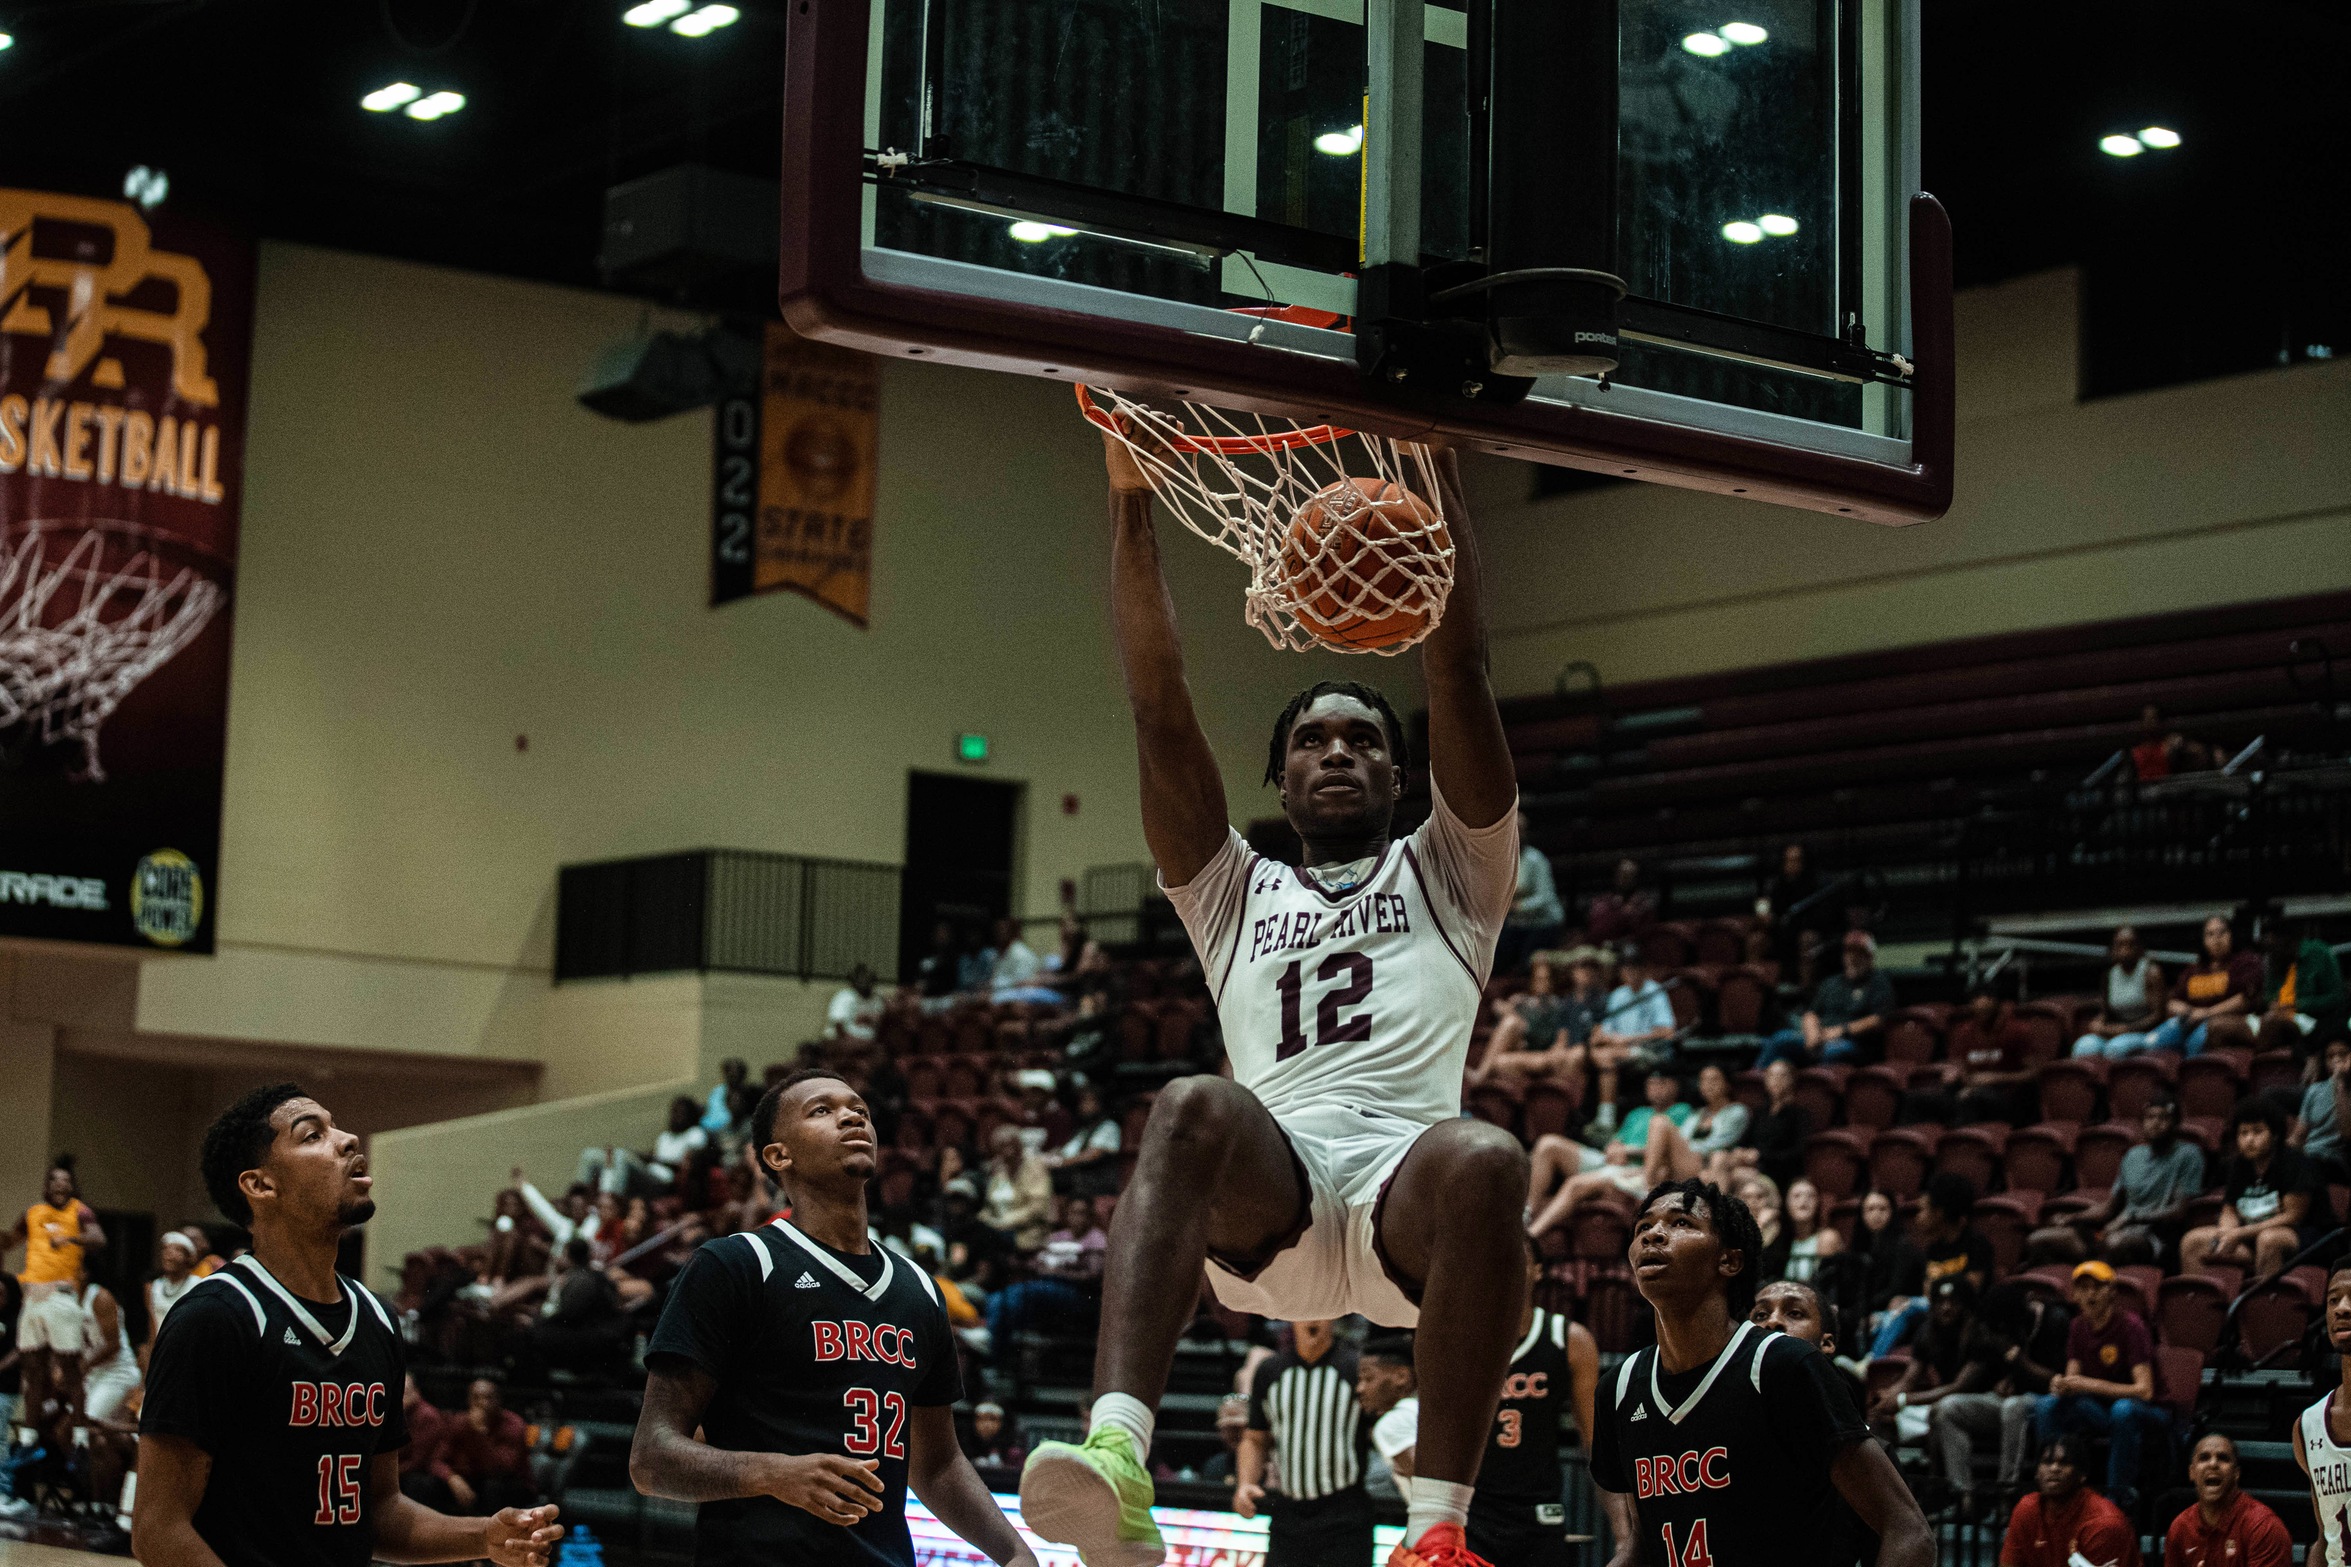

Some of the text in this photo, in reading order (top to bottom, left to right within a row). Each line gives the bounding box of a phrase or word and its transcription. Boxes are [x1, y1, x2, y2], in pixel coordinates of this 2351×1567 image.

[1250, 911, 1322, 964] PEARL
[1275, 951, 1373, 1063] 12
[794, 1281, 821, 1289] adidas
[811, 1319, 916, 1369] BRCC
[288, 1380, 385, 1427] BRCC
[843, 1386, 905, 1461] 32
[1496, 1408, 1523, 1449] 3
[314, 1454, 362, 1525] 15
[1635, 1446, 1731, 1499] BRCC
[1661, 1518, 1714, 1567] 14
